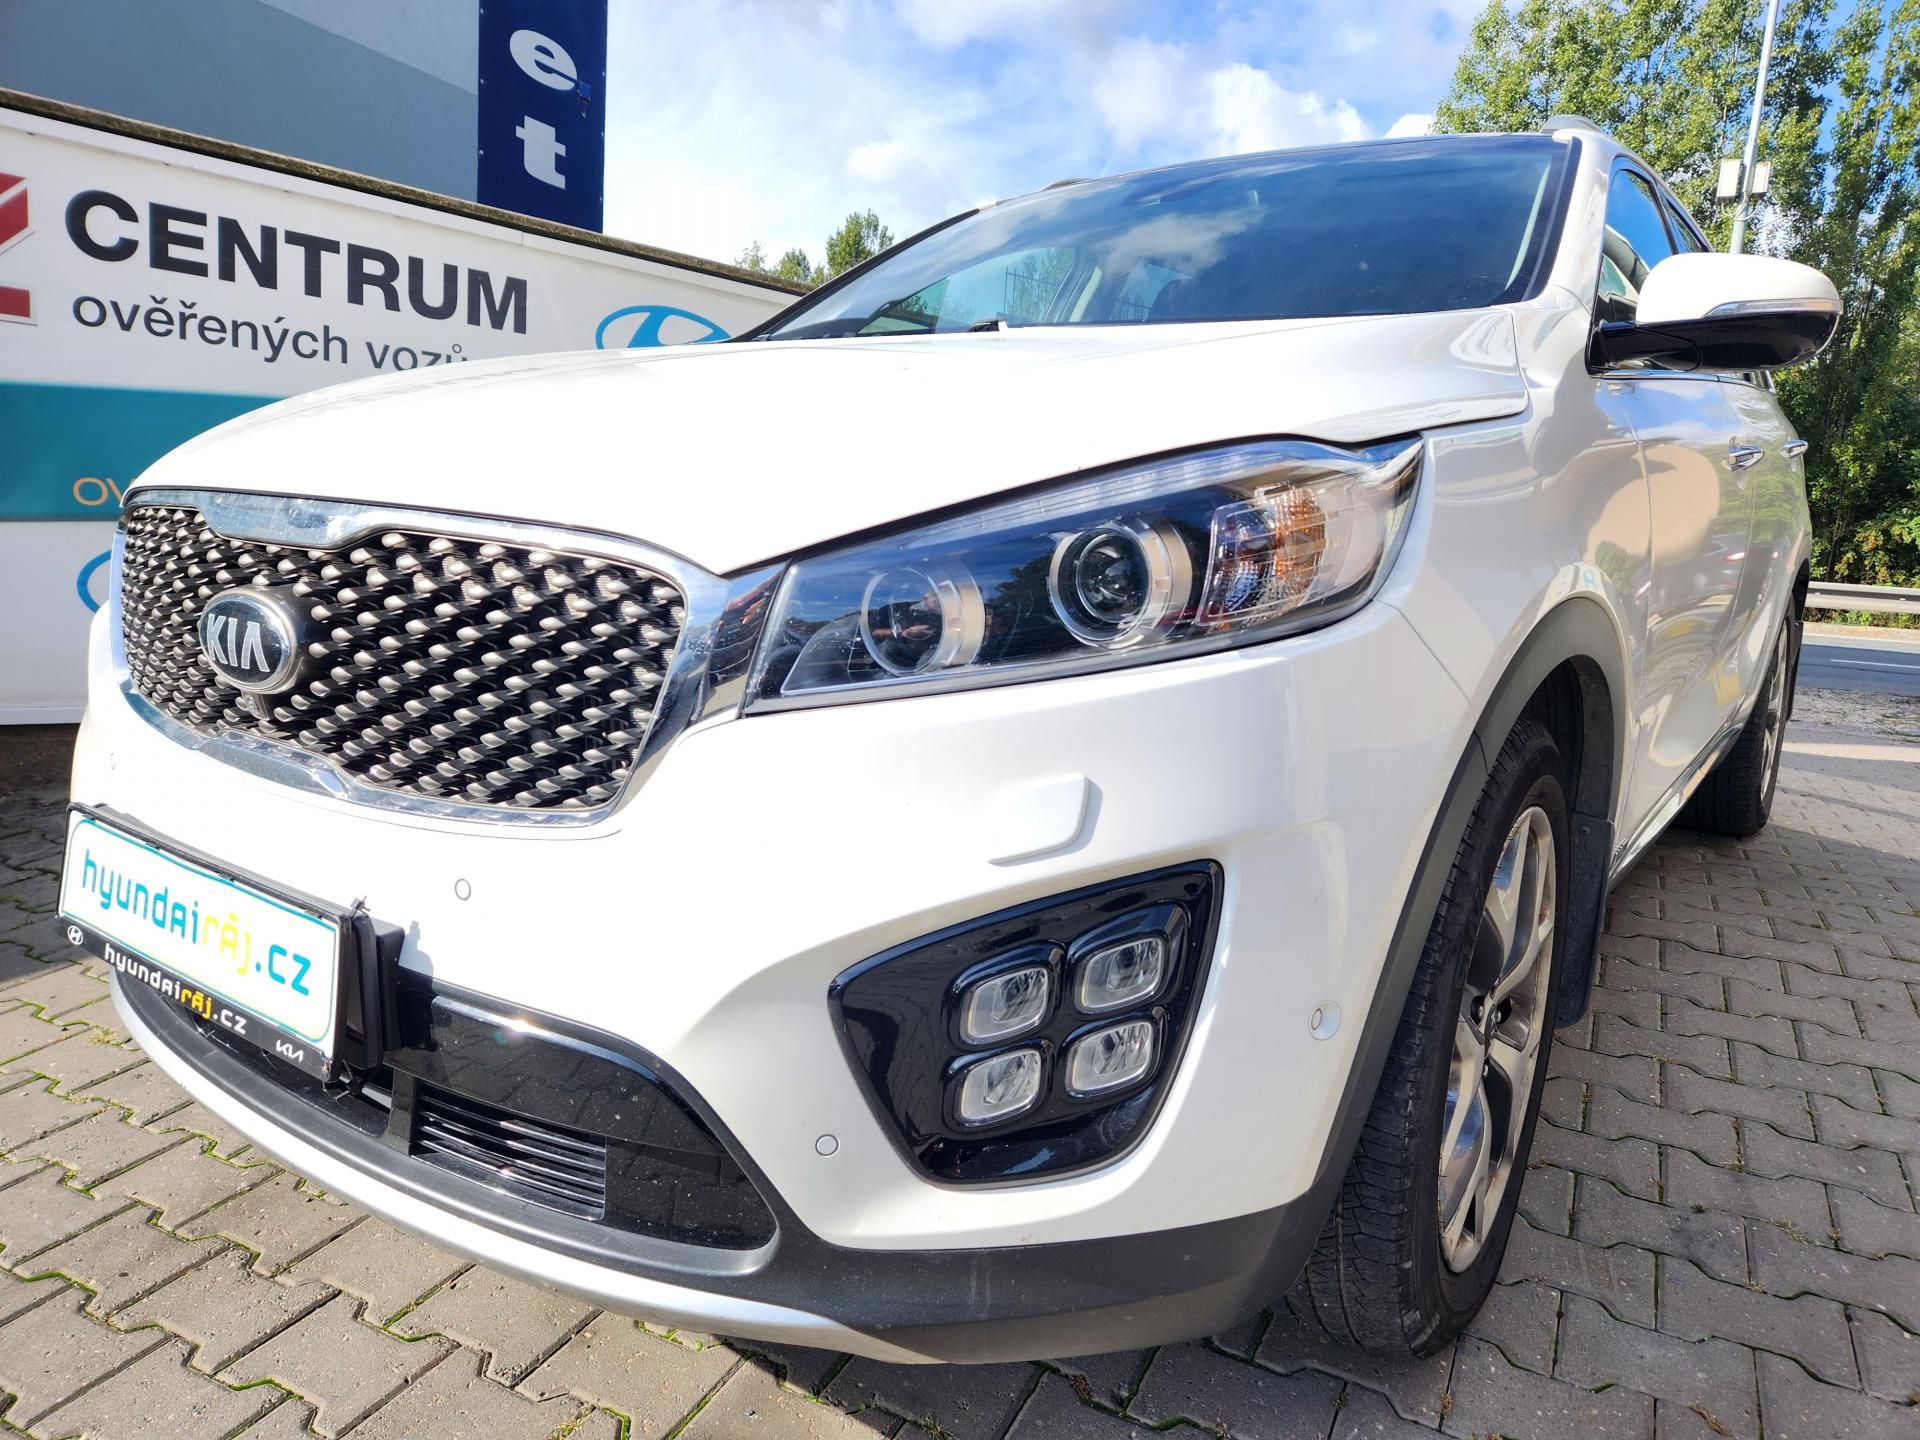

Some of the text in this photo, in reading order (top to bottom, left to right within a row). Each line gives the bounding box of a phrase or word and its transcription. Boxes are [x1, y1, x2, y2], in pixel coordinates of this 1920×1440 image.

[65, 189, 528, 334] CENTRUM
[72, 294, 348, 364] ověřených
[206, 613, 270, 673] KIA
